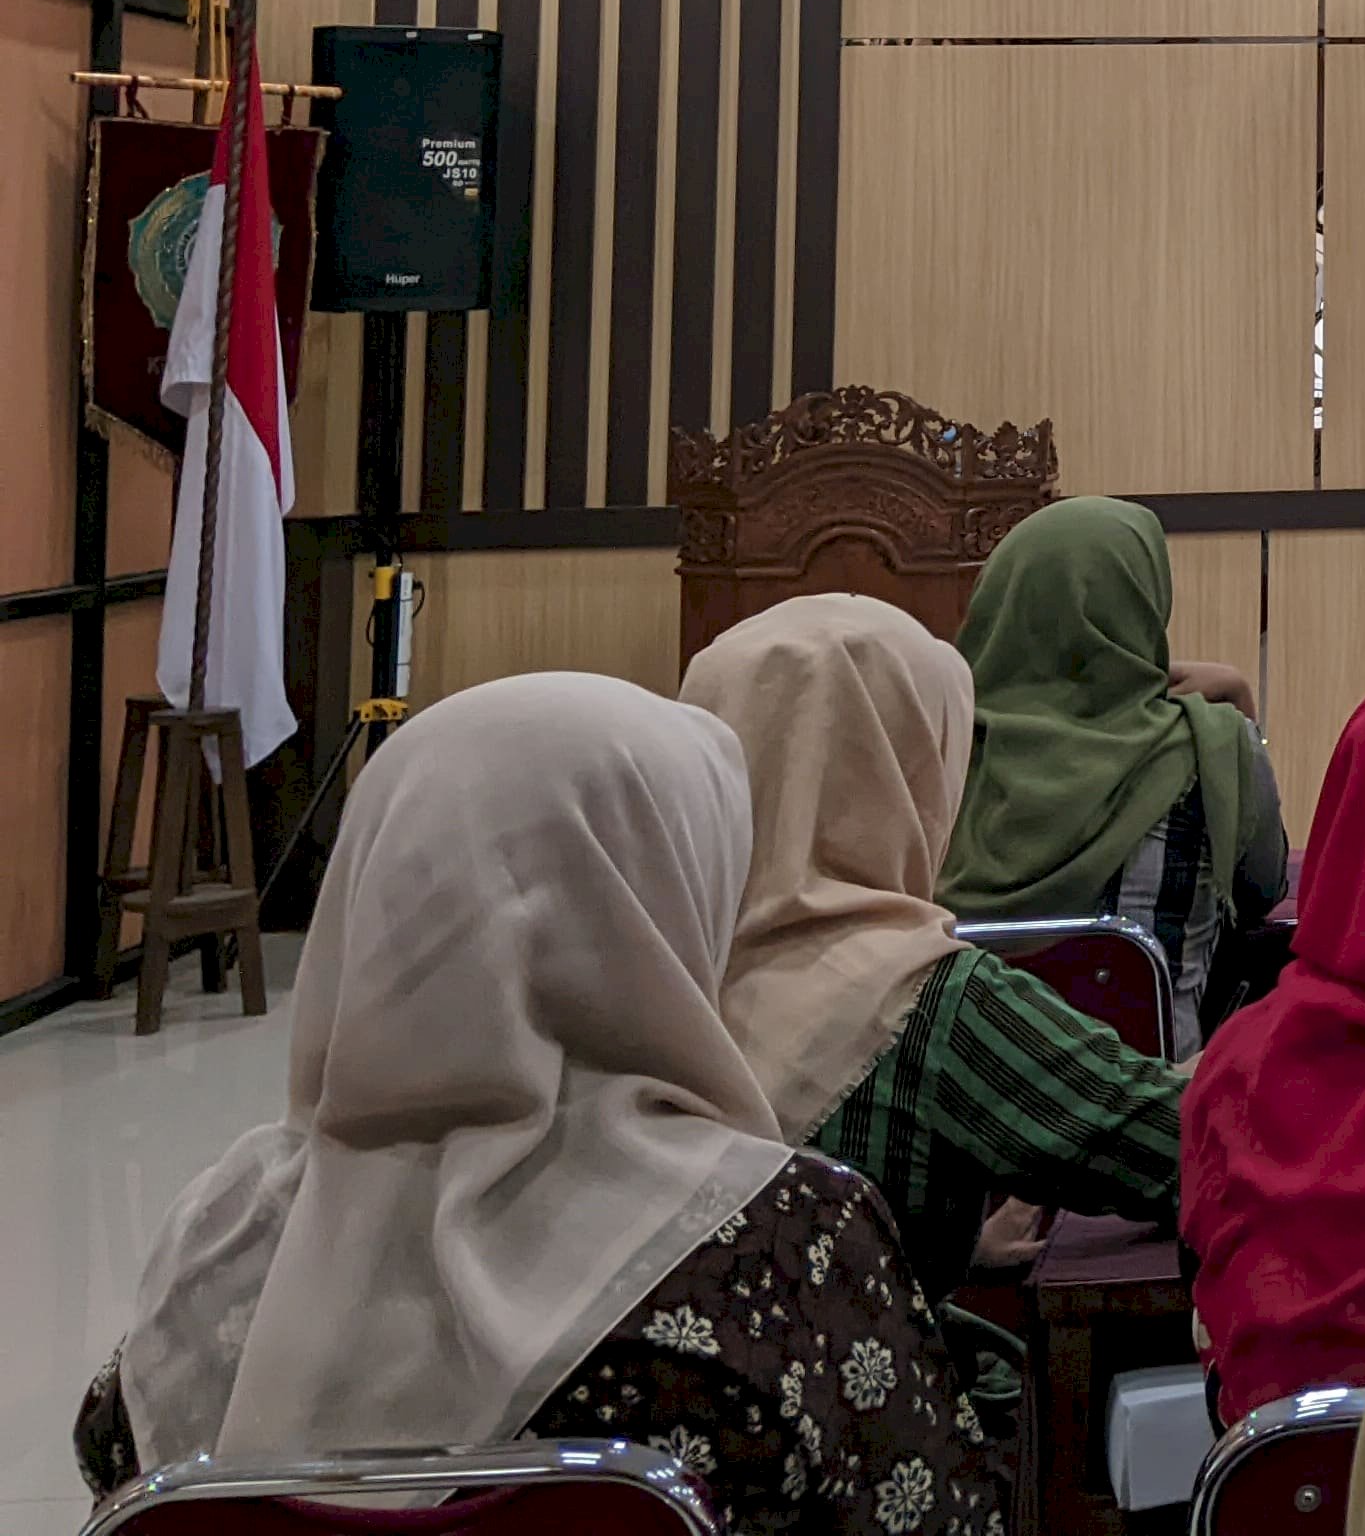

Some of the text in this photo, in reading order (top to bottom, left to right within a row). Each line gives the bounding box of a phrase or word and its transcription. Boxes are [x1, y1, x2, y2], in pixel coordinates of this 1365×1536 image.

[422, 138, 476, 149] Premium
[422, 151, 458, 167] 500
[442, 168, 477, 179] JS10
